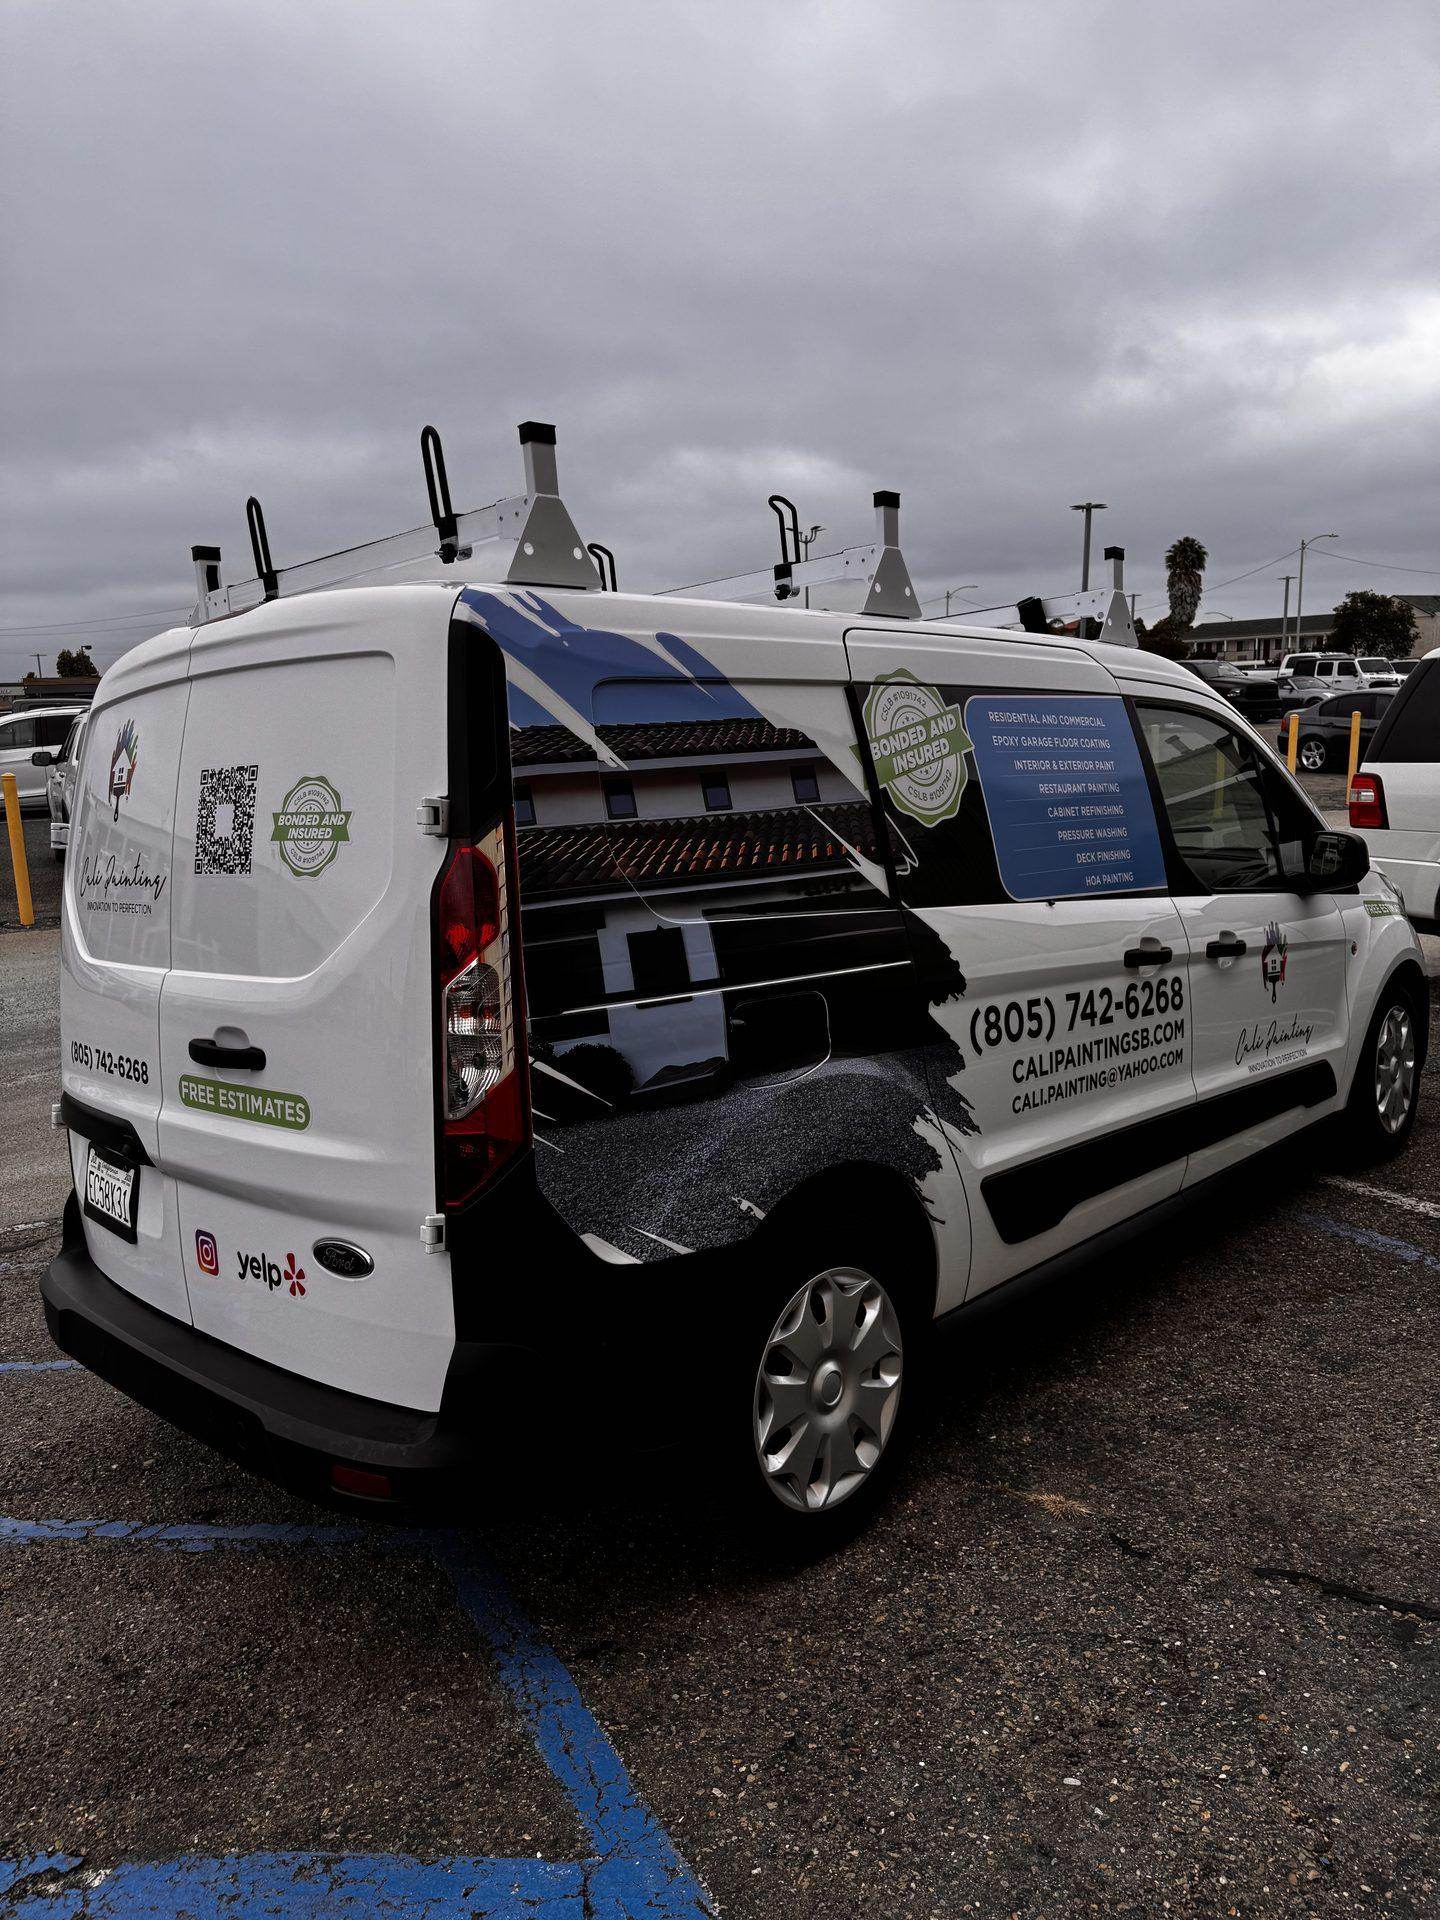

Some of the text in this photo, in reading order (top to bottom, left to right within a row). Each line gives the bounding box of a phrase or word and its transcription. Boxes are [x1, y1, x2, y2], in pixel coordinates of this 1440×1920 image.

[880, 689, 927, 722] CSLB #1091742
[988, 711, 1106, 727] RESIDENTIAL AND COMMERCIAL
[870, 713, 957, 761] BONDED AND
[992, 735, 1111, 749] EPOXY GARAGE FLOOR COATING
[893, 737, 950, 775] INSURED
[1014, 759, 1115, 771] INTERIOR & EXTERIOR PAINT
[907, 768, 953, 802] CSLB #1091742
[1039, 782, 1120, 794] RESTAURANT PAINTING
[278, 814, 346, 826] BONDED AND
[1047, 805, 1124, 818] CABINET REFINISHING
[288, 827, 333, 840] INSURED
[1058, 827, 1128, 841] PRESSURE WASHING
[1076, 849, 1131, 864] DECK FINISHING
[104, 852, 166, 900] Painting
[1085, 872, 1134, 886] HOA PAINTING
[87, 901, 152, 915] INNOVATION TO PERFECTION
[970, 976, 1184, 1056] (805) 742-6268
[1012, 1018, 1184, 1084] CALIPAINTINGSB.COM
[1235, 1012, 1314, 1066] Cali Painting
[71, 1041, 149, 1085] (805) 742-6268
[1282, 1048, 1308, 1064] PERFECTION
[1012, 1048, 1184, 1114] CALI.PAINTING@YAHOO.COM
[181, 1081, 306, 1124] FREE ESTIMATES
[89, 1170, 129, 1224] EC58X31
[236, 1250, 283, 1291] yelp
